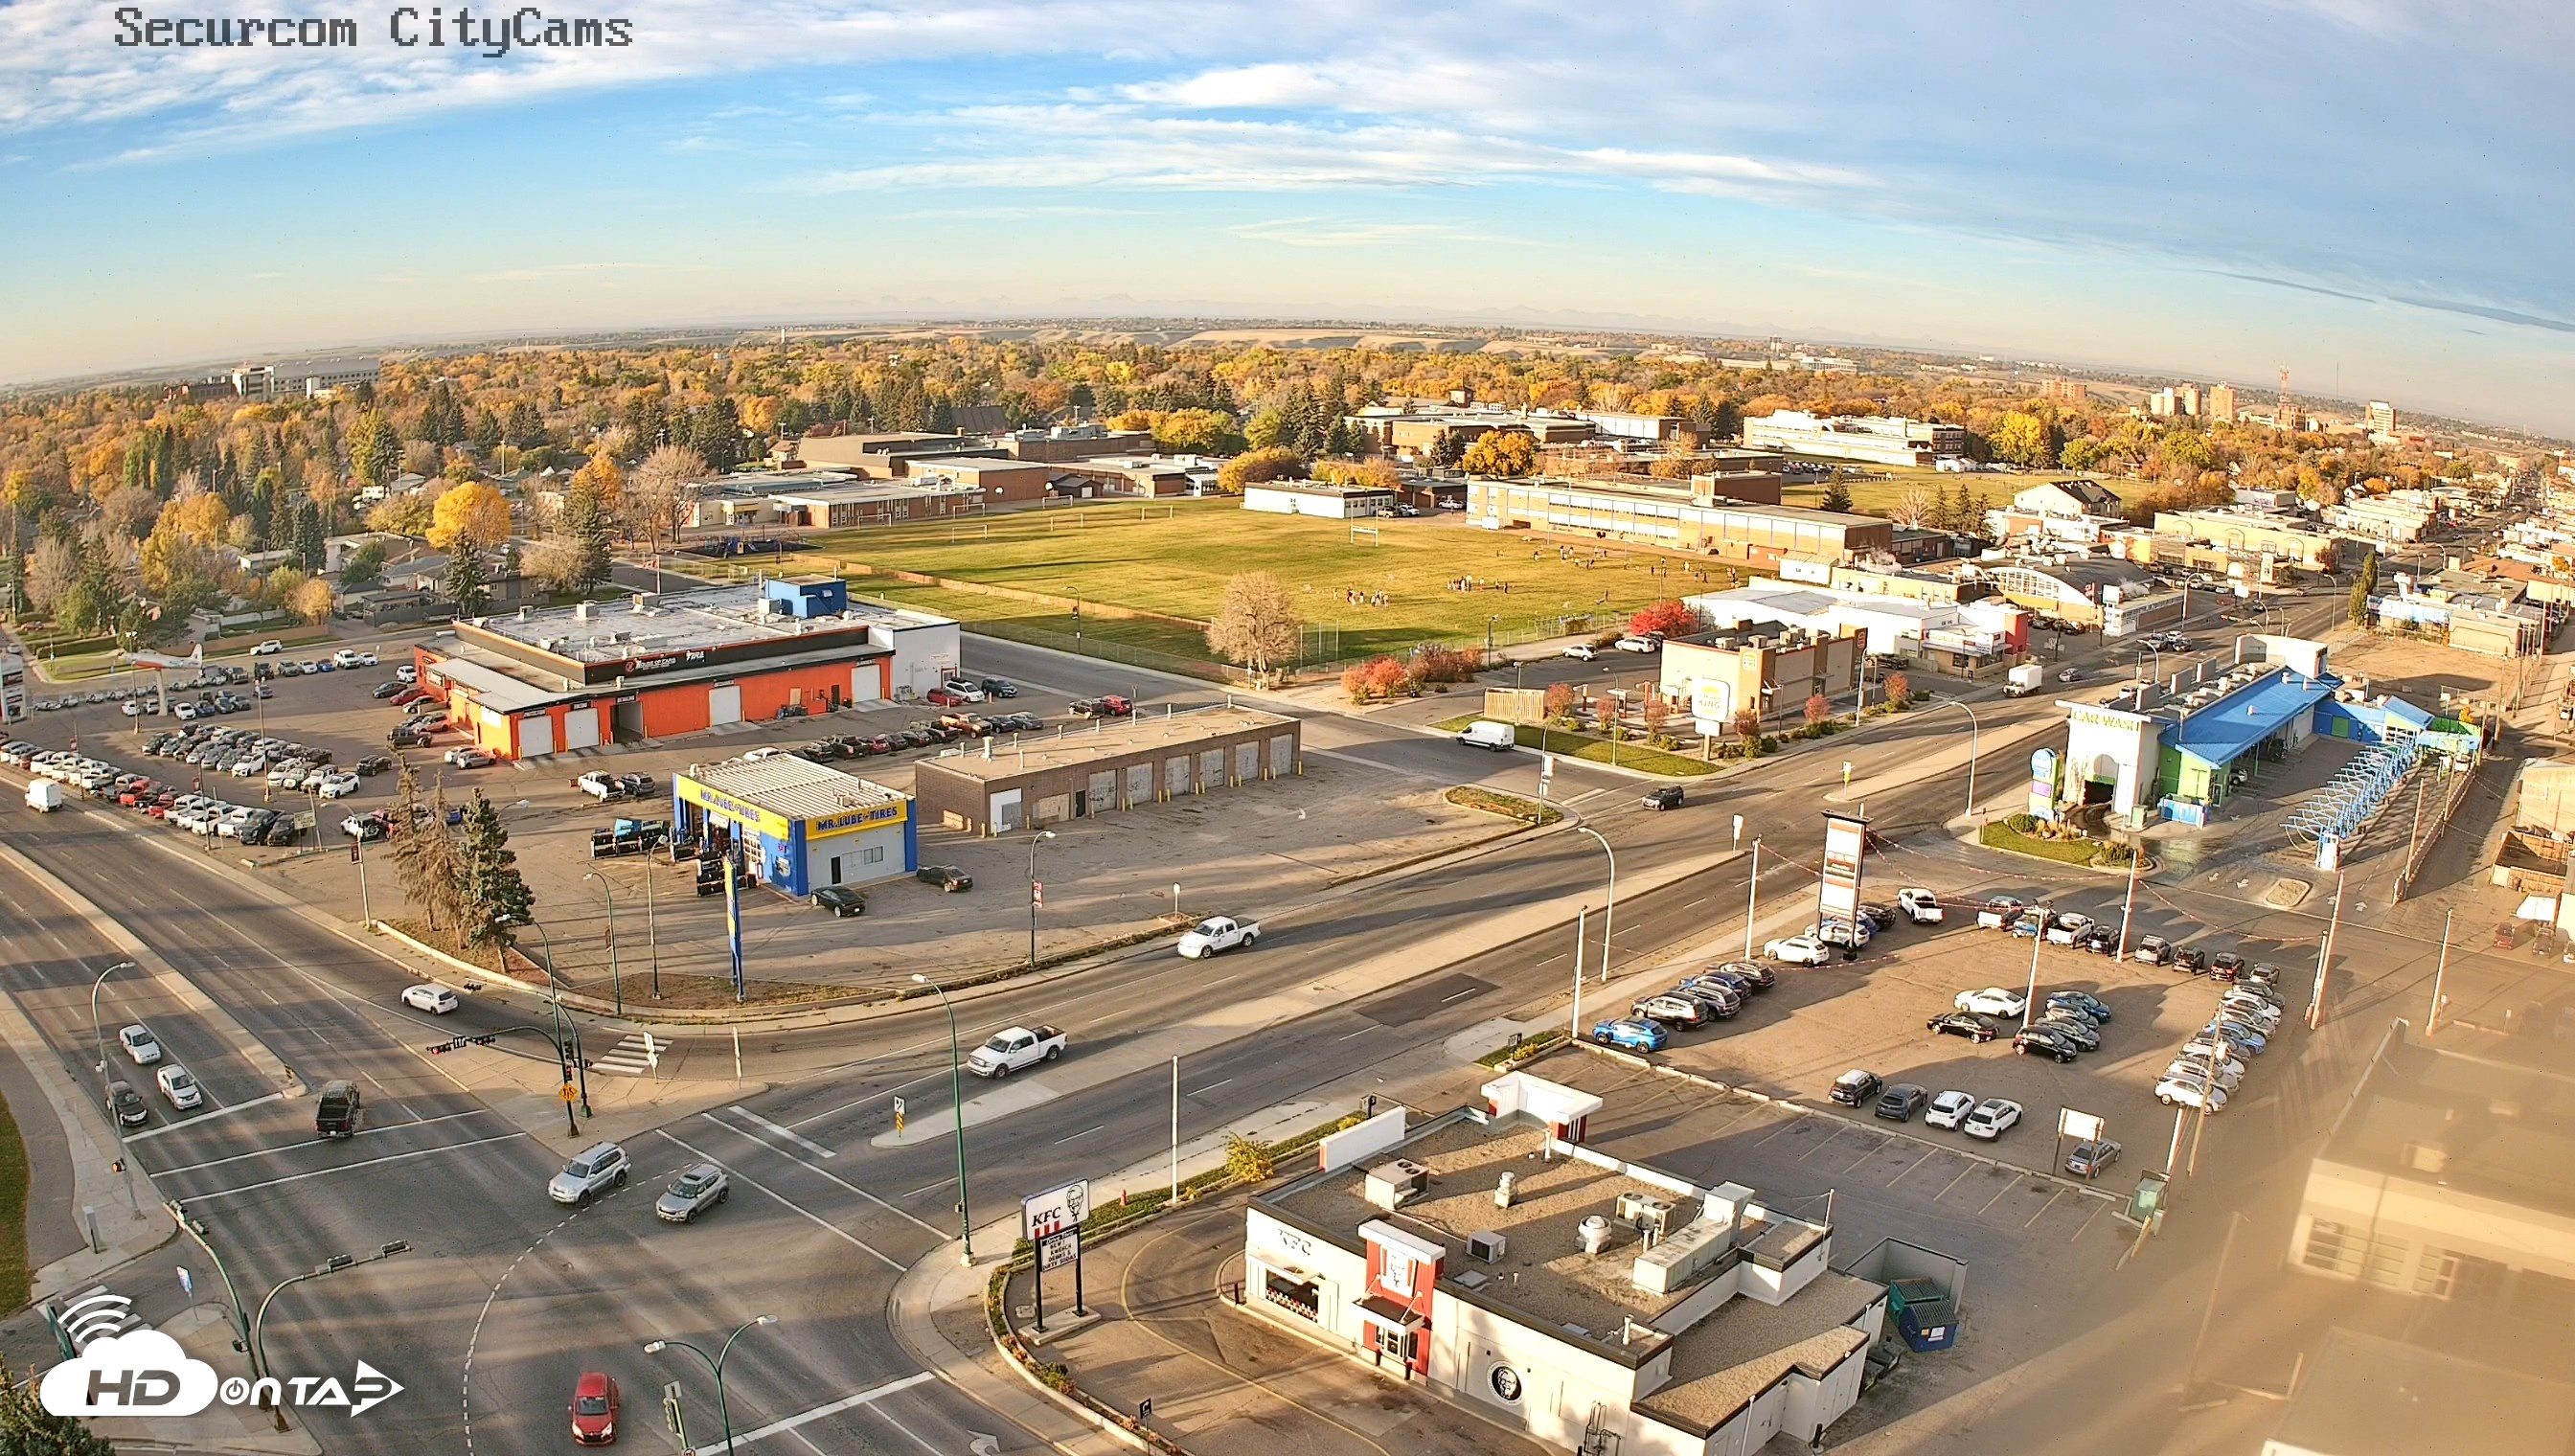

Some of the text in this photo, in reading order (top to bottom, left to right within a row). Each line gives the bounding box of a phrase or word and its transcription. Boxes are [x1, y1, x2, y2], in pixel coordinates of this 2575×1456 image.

[2074, 710, 2099, 725] CAR
[838, 812, 863, 827] LUBE
[870, 807, 898, 821] TIRES
[1032, 1207, 1061, 1226] KFC
